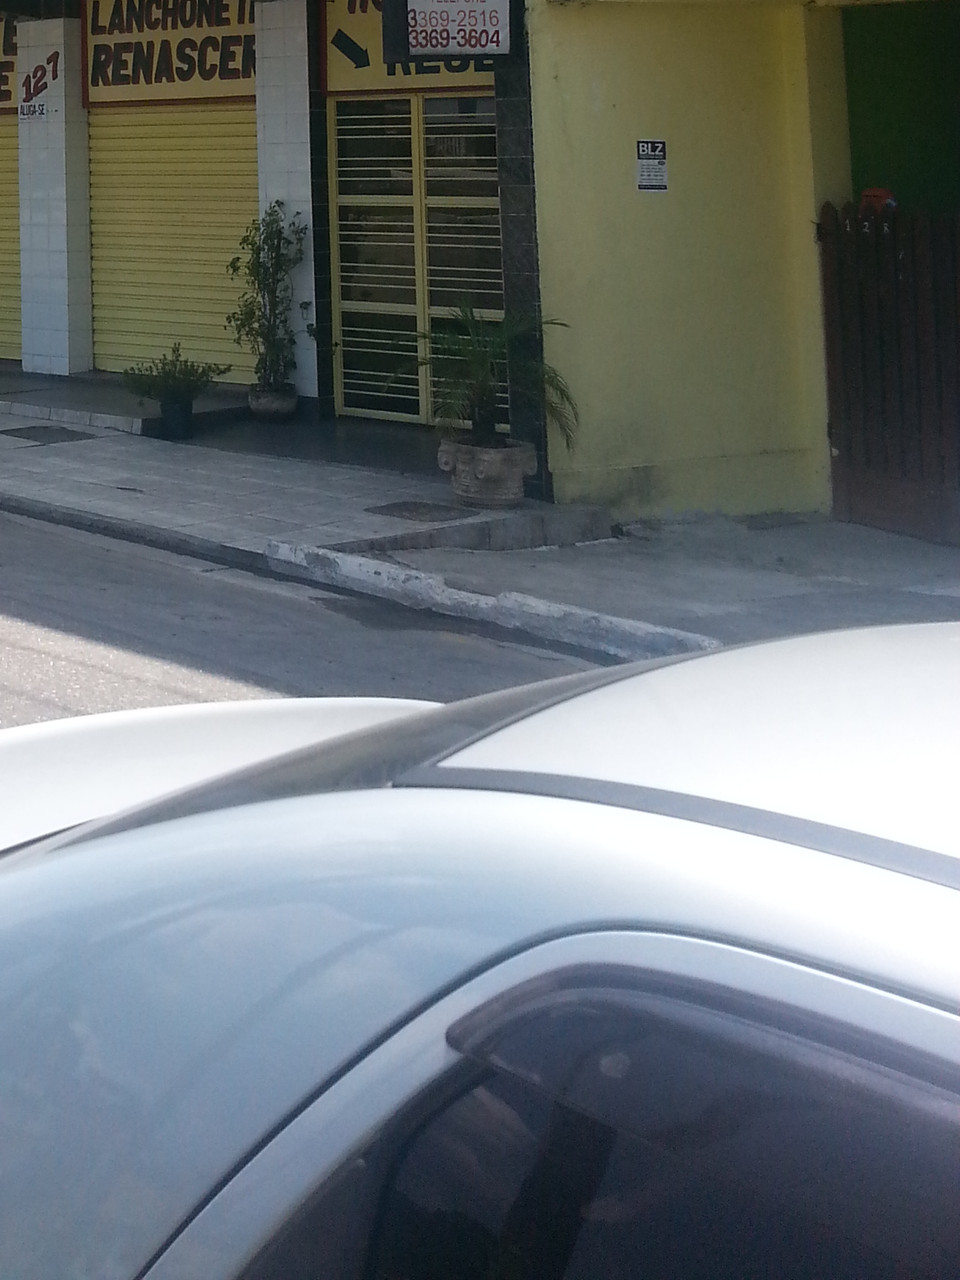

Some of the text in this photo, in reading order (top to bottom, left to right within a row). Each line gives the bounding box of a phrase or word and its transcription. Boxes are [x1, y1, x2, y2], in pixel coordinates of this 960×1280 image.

[408, 8, 500, 28] 3369-2516
[409, 29, 501, 48] 3369-3604
[22, 50, 60, 103] 127
[639, 143, 664, 155] BLZ
